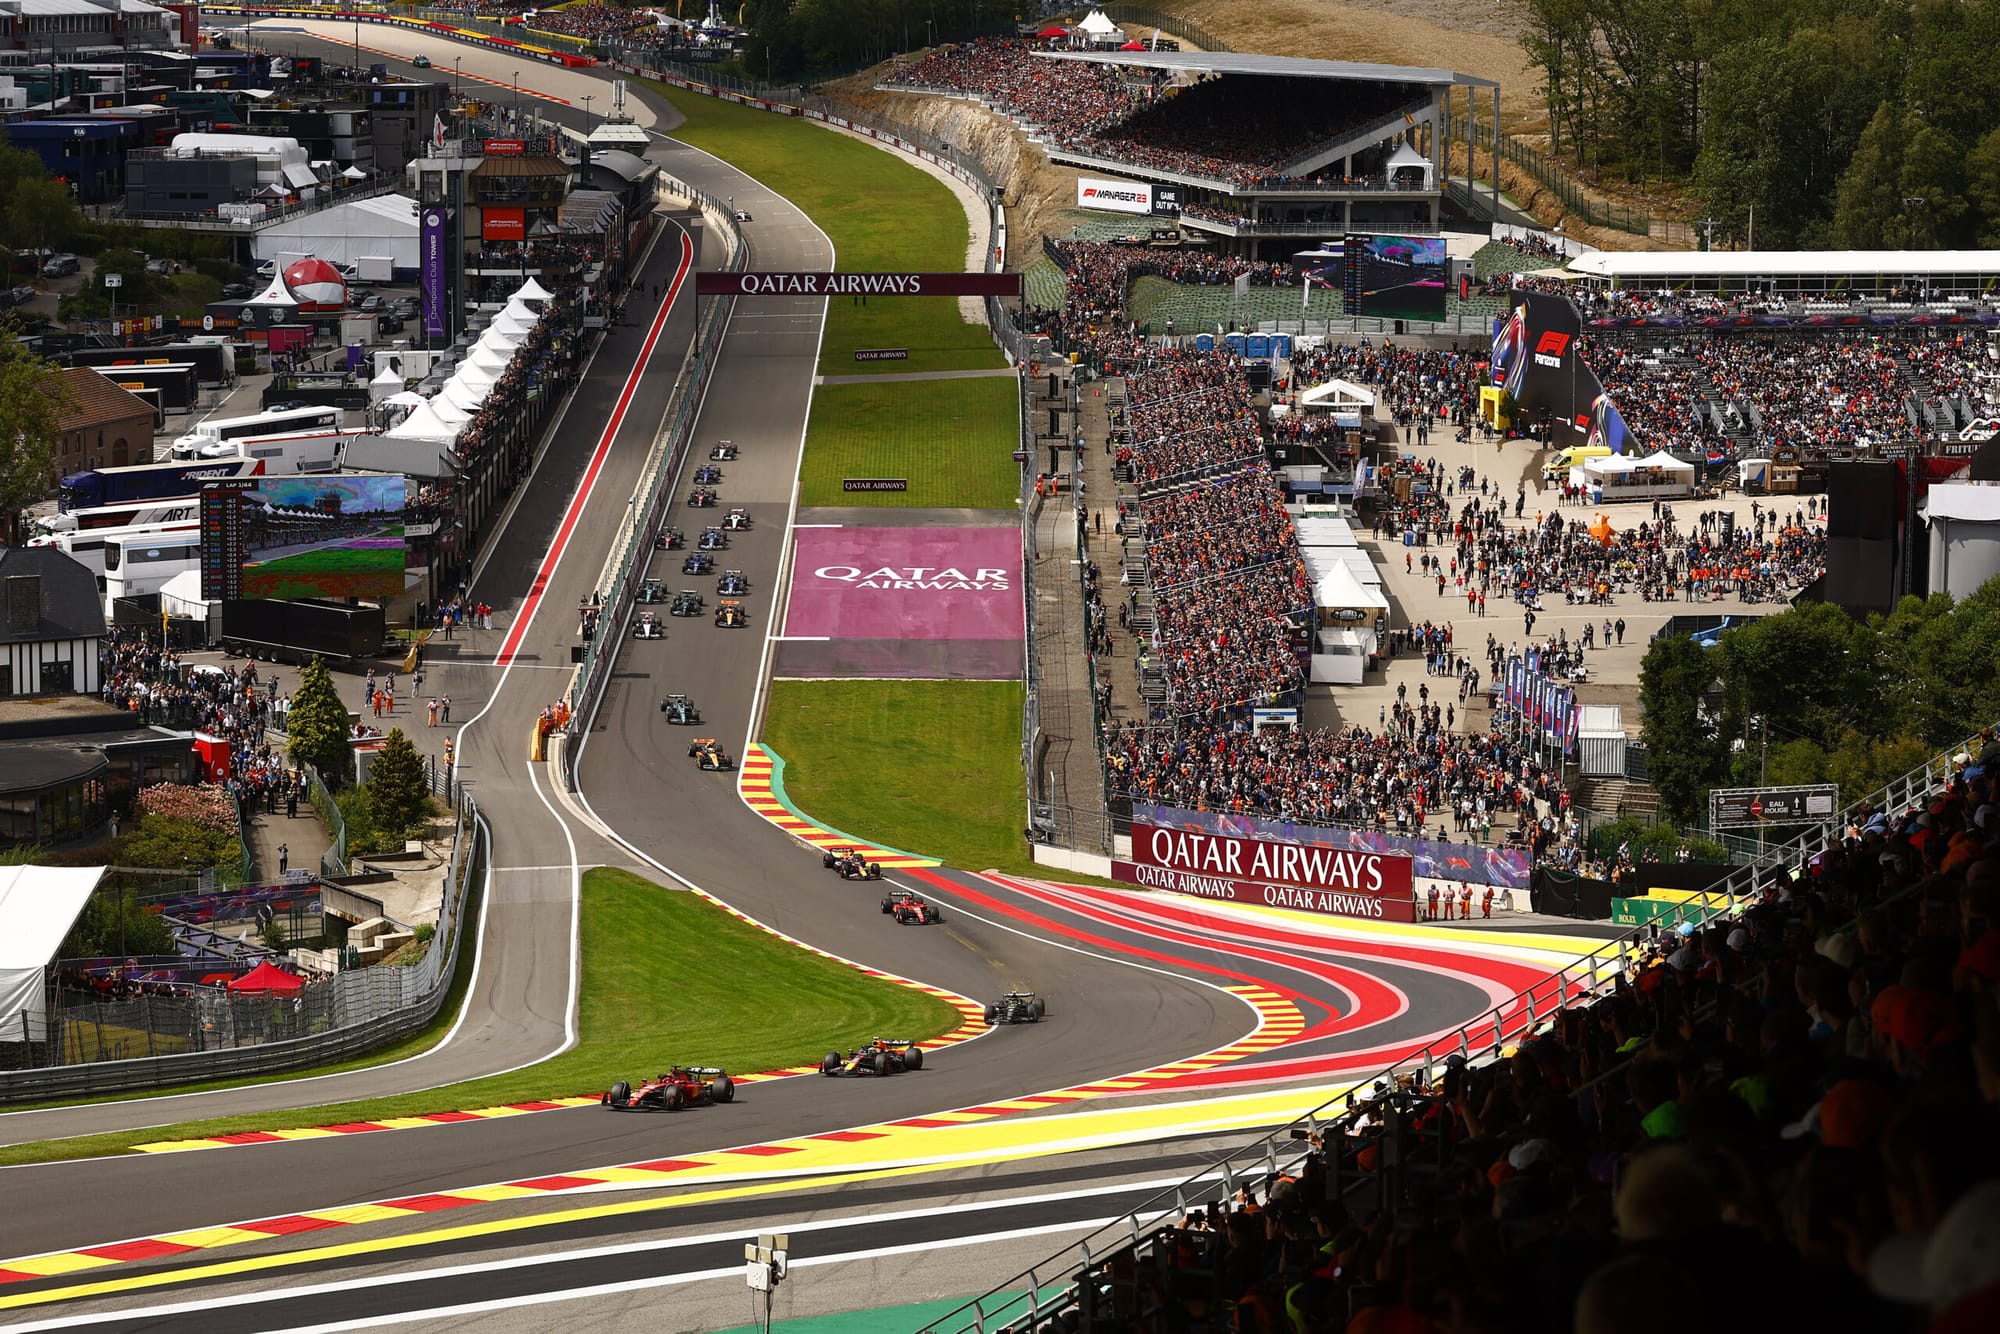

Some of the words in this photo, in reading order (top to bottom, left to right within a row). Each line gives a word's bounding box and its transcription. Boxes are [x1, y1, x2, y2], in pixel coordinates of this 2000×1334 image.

[691, 51, 712, 59] PMR
[1097, 189, 1136, 202] MANAGER
[1137, 193, 1147, 203] 23
[1160, 192, 1175, 200] GAME
[1156, 201, 1167, 209] OUT
[740, 274, 817, 294] QATAR
[824, 275, 921, 293] AIRWAYS
[856, 352, 878, 360] QATAR
[880, 351, 906, 359] AIRWAYS
[845, 482, 871, 490] QATAR
[160, 507, 195, 522] ART
[814, 566, 1009, 582] QATAR
[855, 580, 1010, 591] AIRWAYS
[1764, 806, 1789, 814] ROUGE
[1152, 828, 1243, 875] QATAR
[1250, 842, 1383, 892] AIRWAYS
[1135, 865, 1176, 890] QATAR
[1178, 875, 1235, 899] AIRWAYS
[1263, 886, 1314, 909] QATAR
[1317, 892, 1383, 918] AIRWAYS
[1618, 914, 1637, 923] ROLEX
